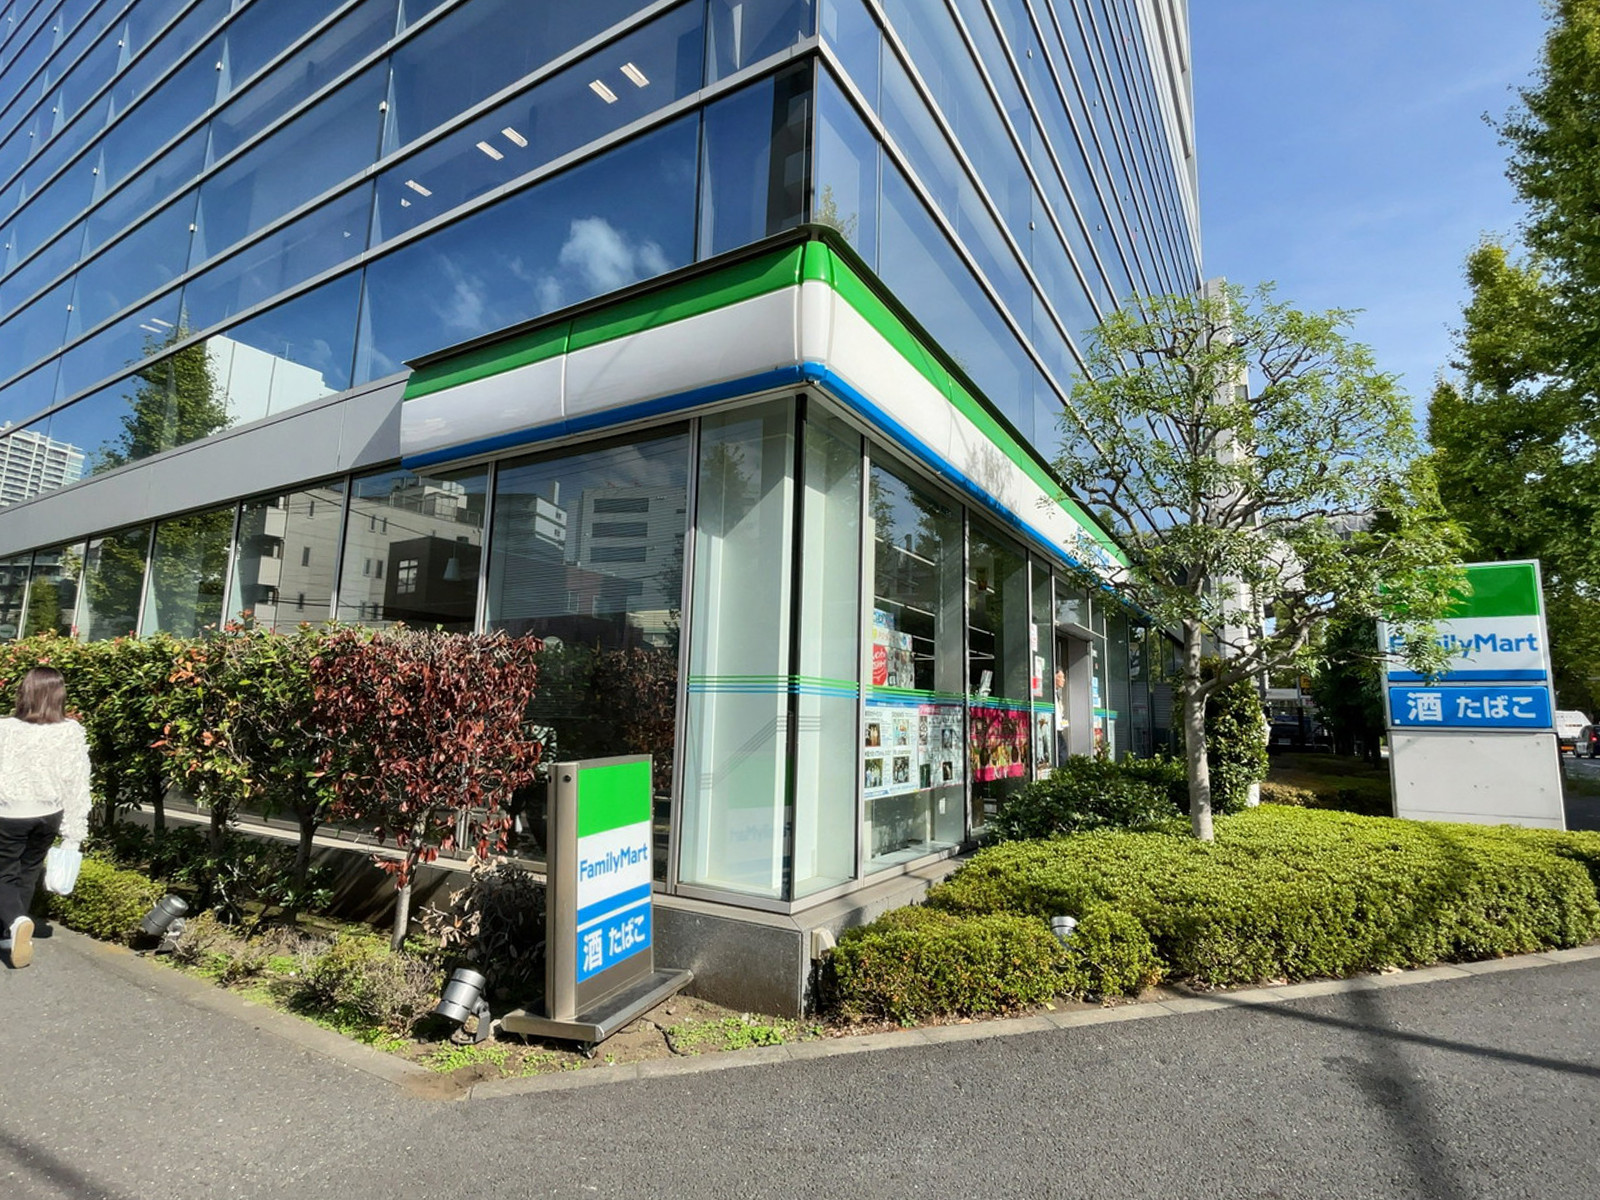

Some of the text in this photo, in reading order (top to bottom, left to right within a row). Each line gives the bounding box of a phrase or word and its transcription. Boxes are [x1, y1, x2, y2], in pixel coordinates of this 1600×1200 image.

[1388, 632, 1539, 659] FilyMart
[1407, 691, 1537, 722] 酒 たばこ
[579, 843, 648, 882] FamilyMart
[583, 915, 646, 972] 酒 たばこ
